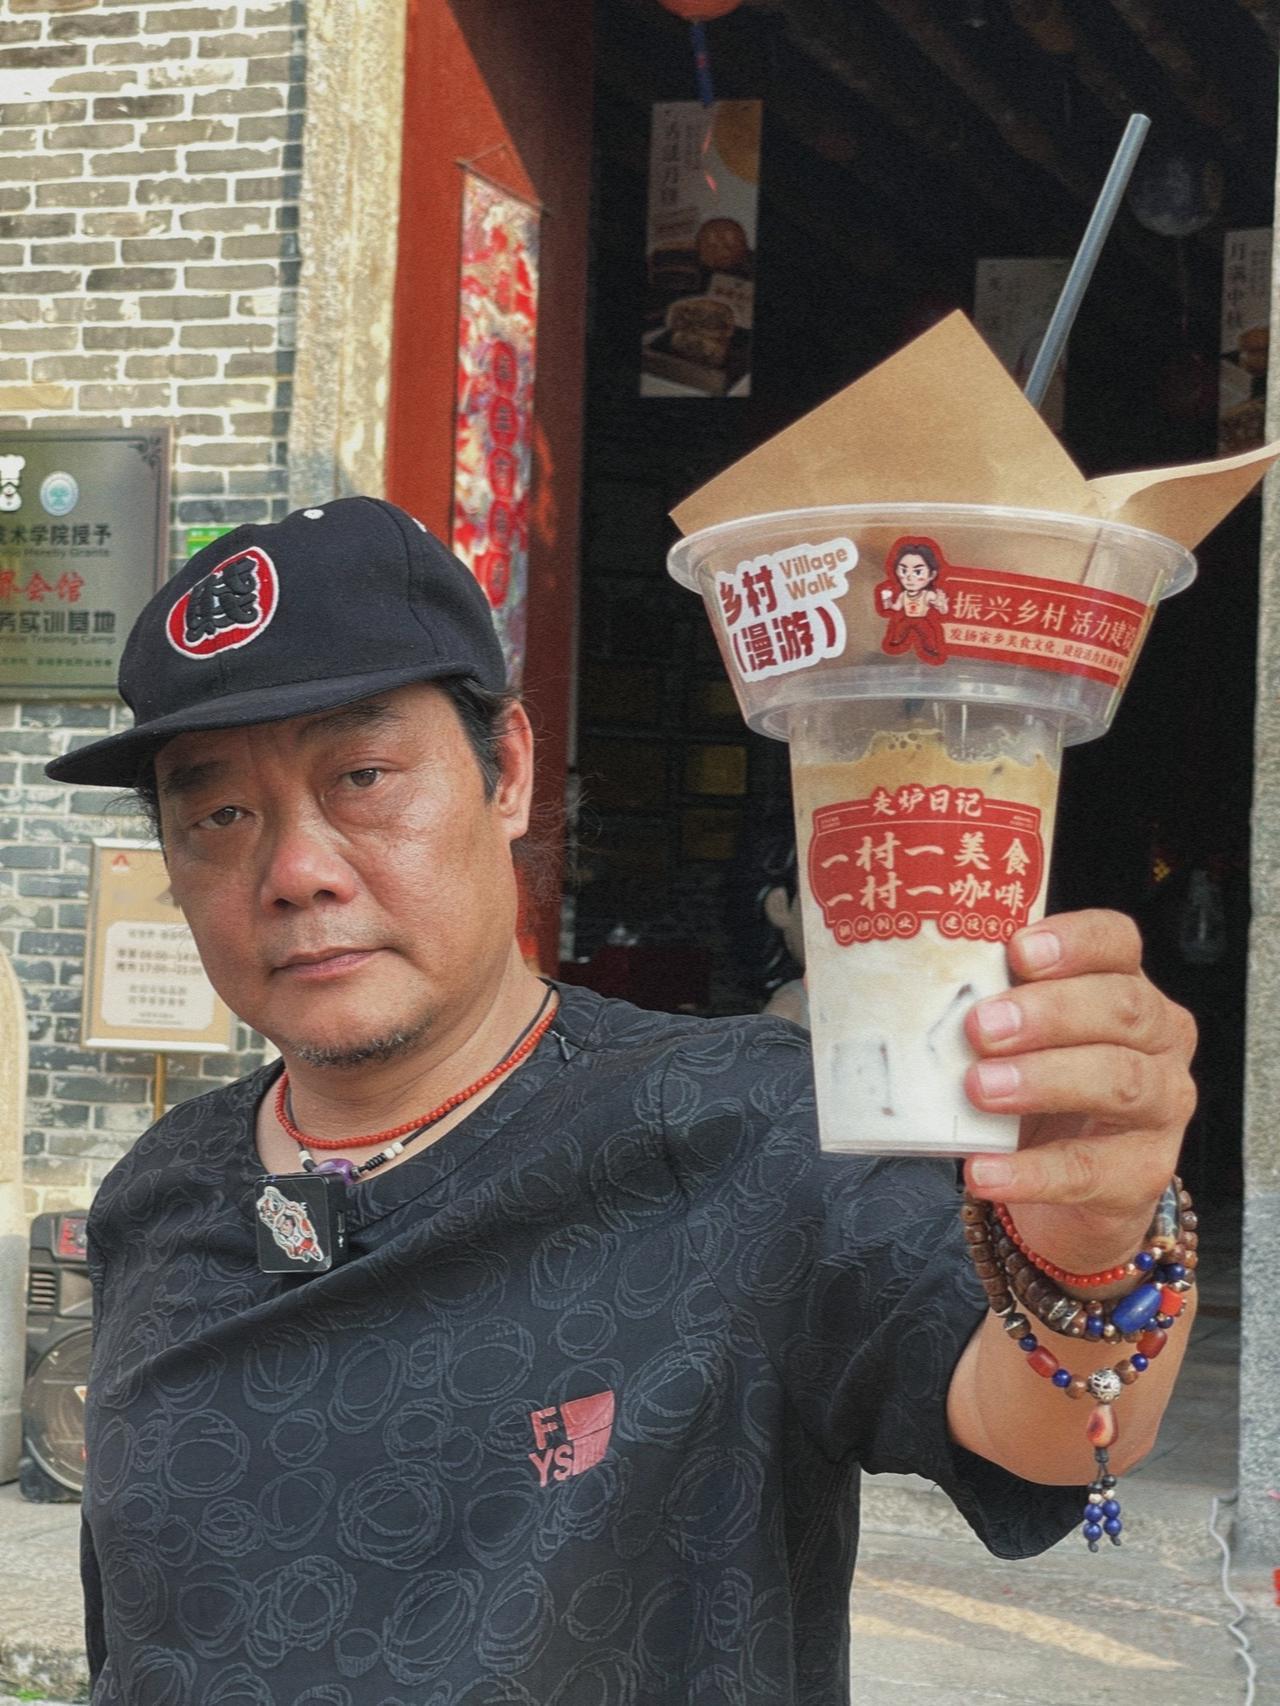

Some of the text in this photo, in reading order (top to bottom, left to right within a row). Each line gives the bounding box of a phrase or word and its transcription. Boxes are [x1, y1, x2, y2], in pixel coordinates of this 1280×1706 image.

[779, 548, 848, 579] Village
[720, 564, 777, 627] 乡村
[785, 572, 837, 600] Walk
[952, 591, 1067, 632] 振兴乡村
[821, 831, 1031, 877] 一村一美食
[827, 871, 1025, 916] 一村一咖啡
